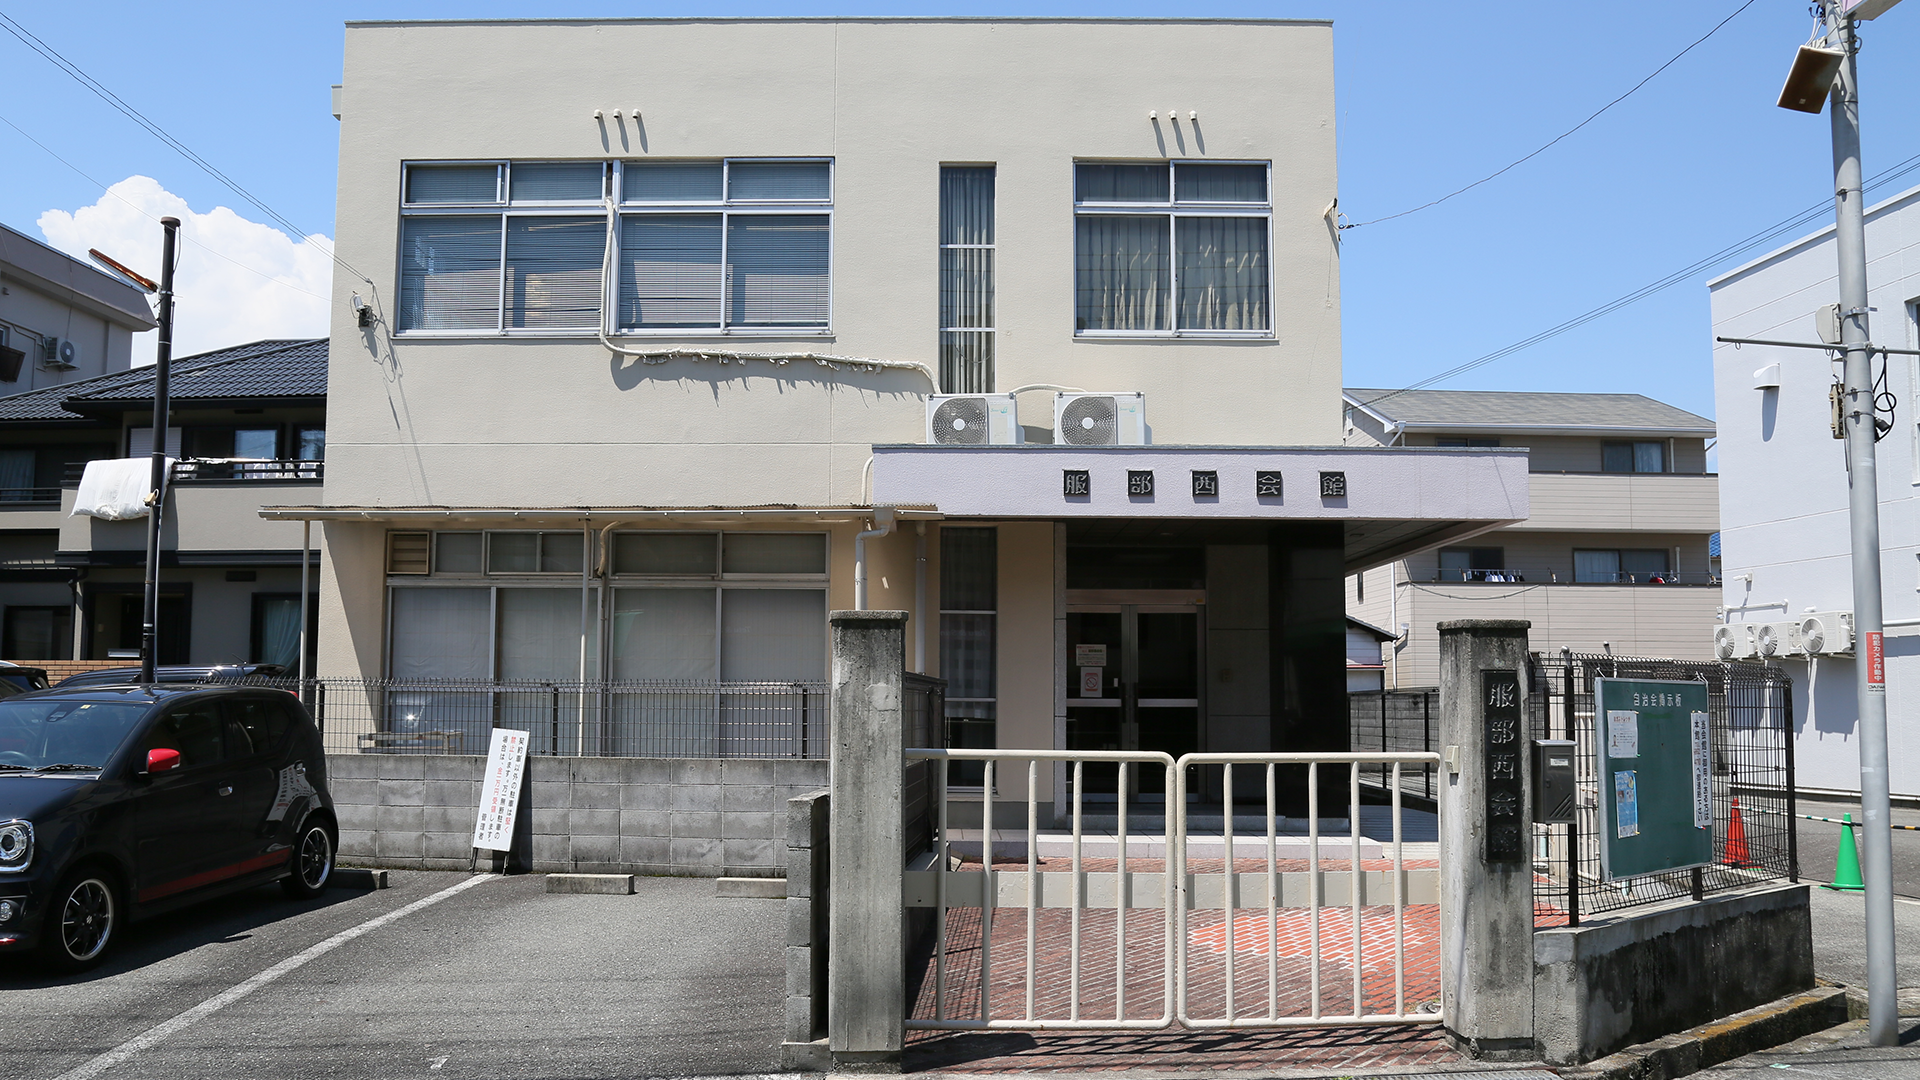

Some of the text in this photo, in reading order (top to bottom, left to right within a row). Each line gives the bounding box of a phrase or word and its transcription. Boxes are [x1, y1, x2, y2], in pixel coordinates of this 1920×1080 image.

[1064, 473, 1346, 497] 服部西会館
[1872, 634, 1882, 681] 防犯カメラ作動中
[1633, 692, 1682, 707] 自治会掲示板
[1488, 682, 1518, 853] 服部西会館
[478, 813, 487, 840] 管理者
